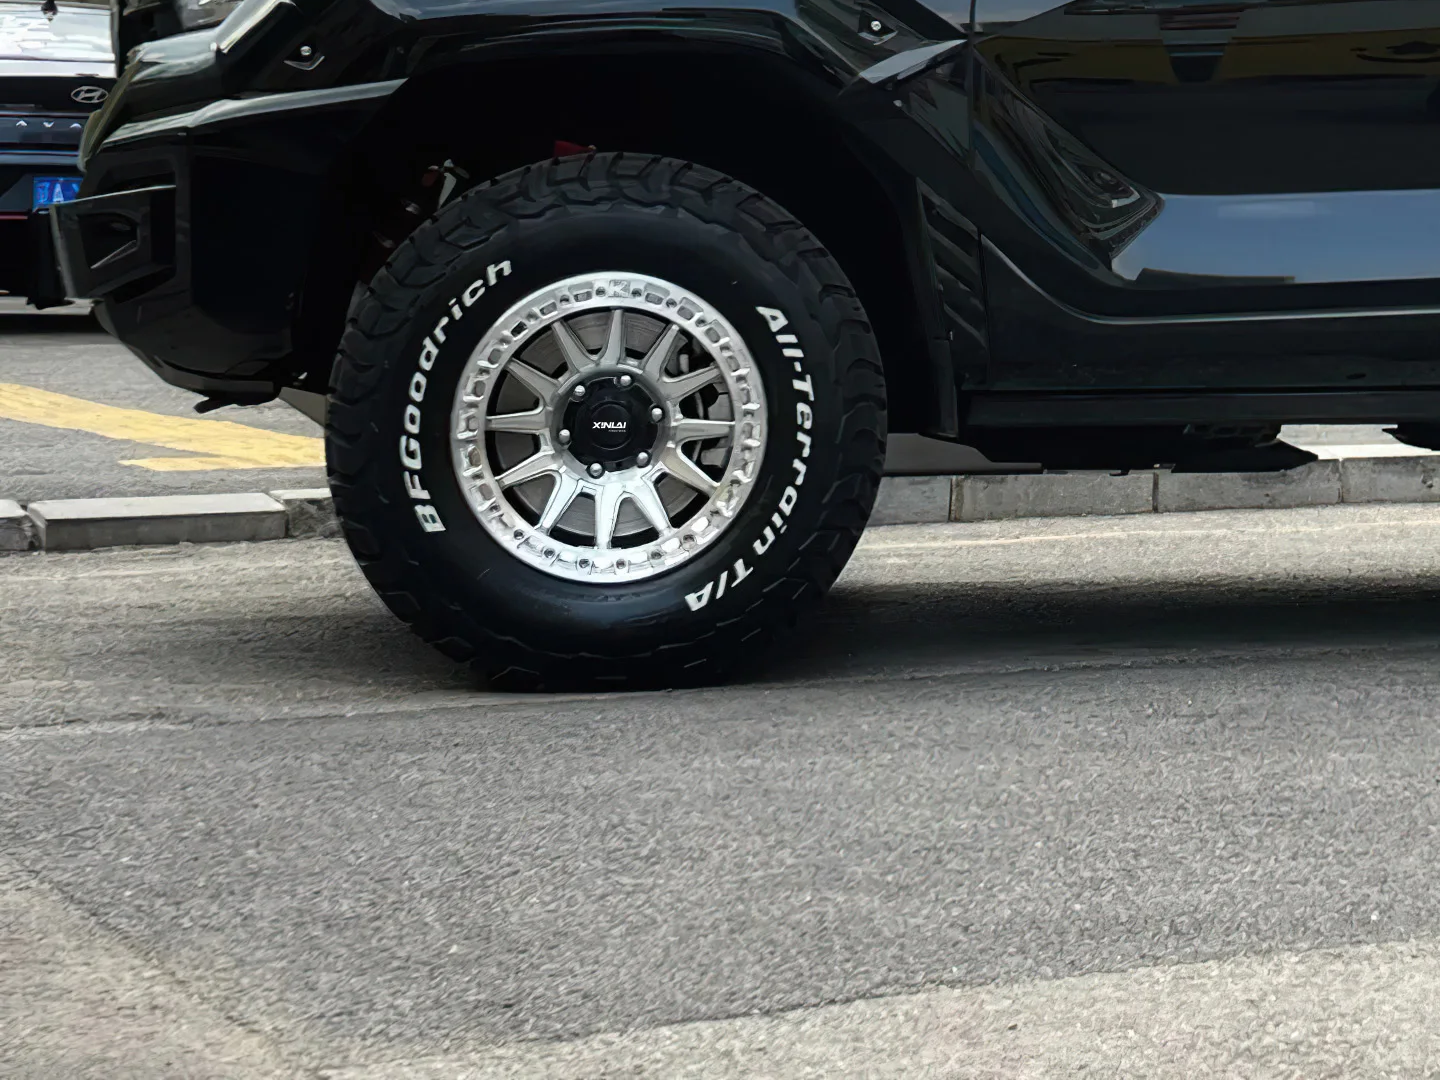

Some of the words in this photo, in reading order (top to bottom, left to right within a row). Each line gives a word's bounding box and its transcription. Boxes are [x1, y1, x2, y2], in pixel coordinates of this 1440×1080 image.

[400, 260, 512, 533] BFGoodrich
[592, 421, 627, 429] XINLAI
[752, 306, 815, 555] All-Terrain
[684, 558, 754, 612] T/A
